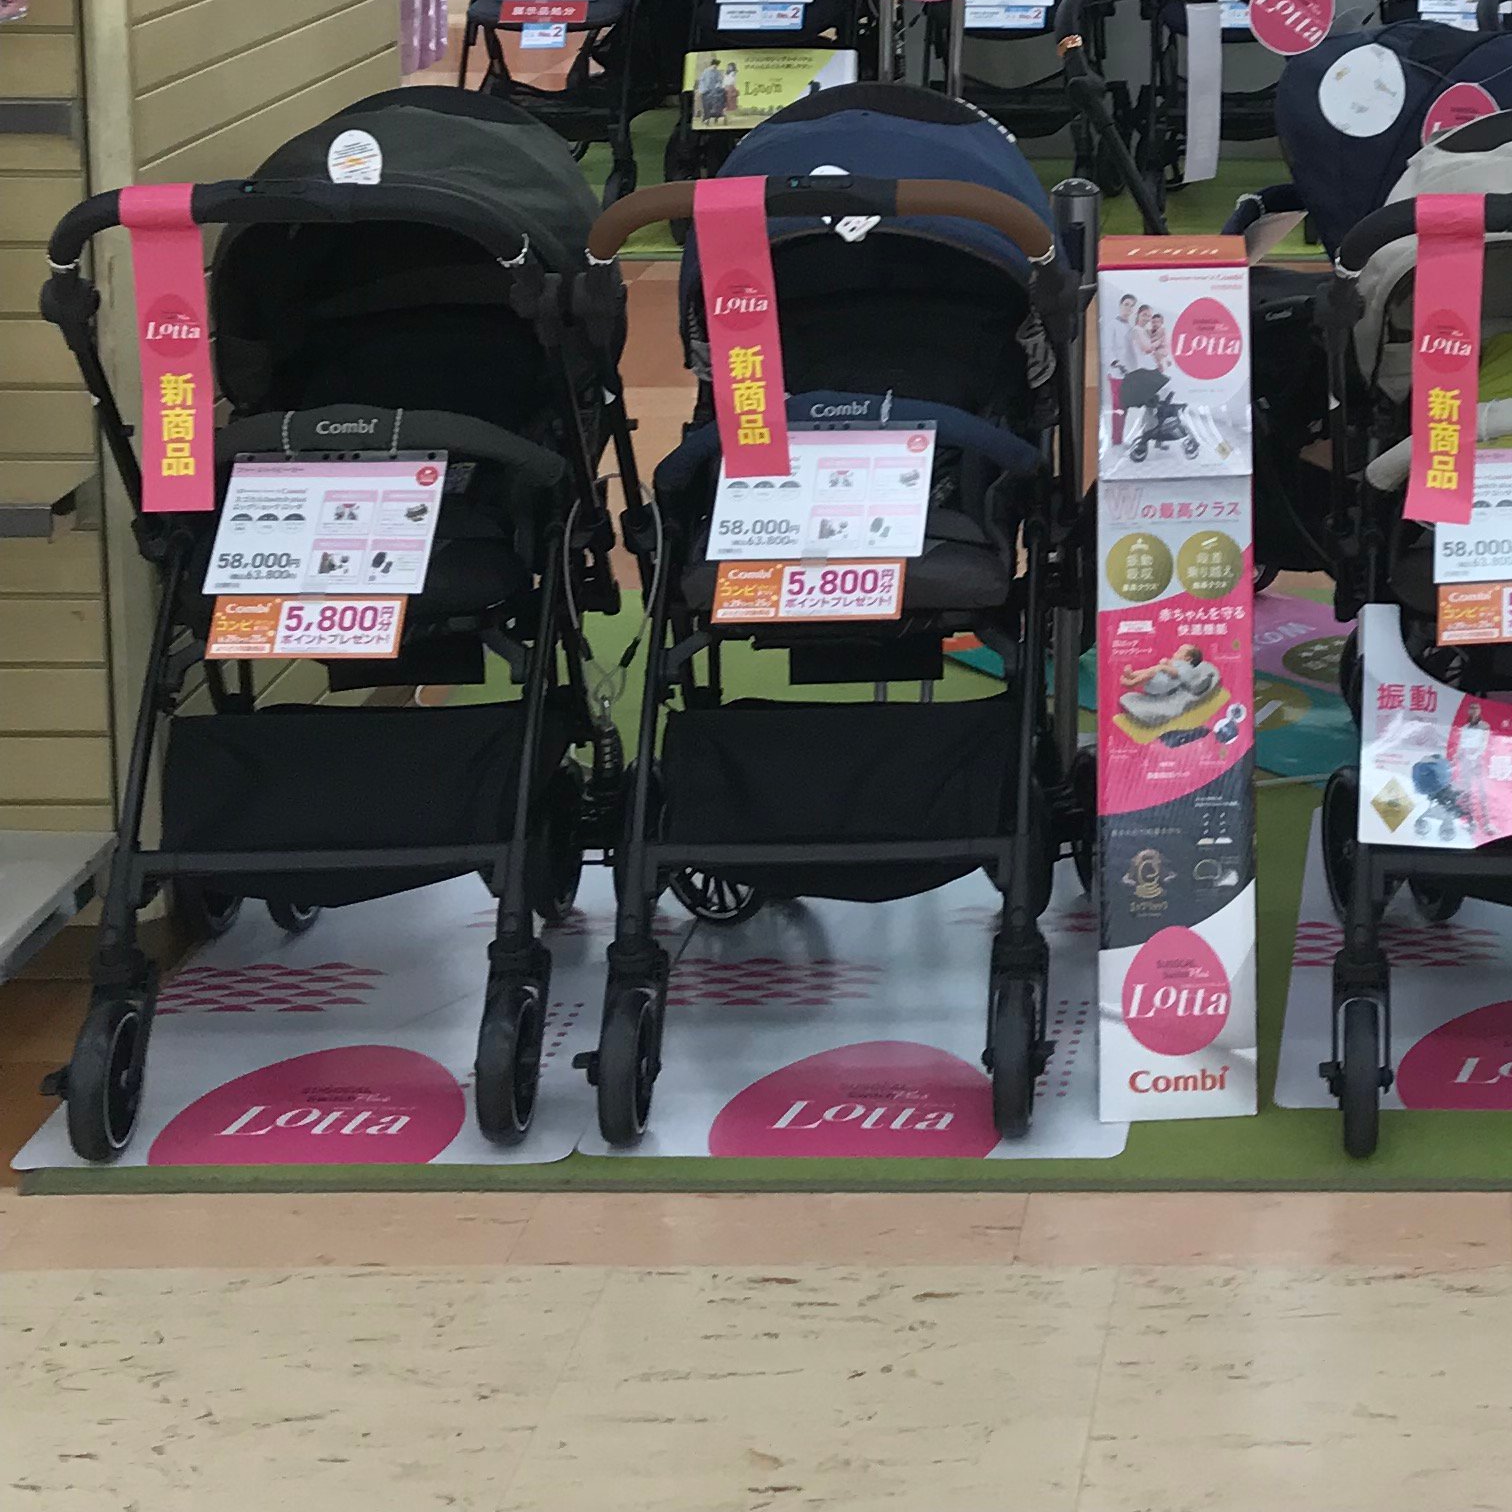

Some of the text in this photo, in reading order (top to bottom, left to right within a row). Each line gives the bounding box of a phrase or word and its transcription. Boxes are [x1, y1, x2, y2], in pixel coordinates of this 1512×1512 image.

[713, 295, 769, 317] Lotta
[145, 318, 201, 341] Lotta
[1174, 332, 1242, 356] Lotta
[1418, 334, 1473, 358] Lotta
[728, 344, 771, 447] 新商品
[810, 399, 872, 420] Combi
[159, 373, 197, 477] 新商品
[315, 417, 379, 437] Combi
[1426, 386, 1463, 491] 新商品
[719, 519, 800, 535] 58,000円
[217, 552, 301, 570] 58,000円
[728, 569, 773, 580] Combi
[787, 569, 879, 596] 5,800
[225, 603, 272, 614] Combi
[285, 605, 378, 631] 5,800
[1376, 682, 1438, 714] 振動
[1126, 982, 1229, 1019] Lotta
[1128, 1065, 1231, 1094] Combi
[215, 1104, 411, 1136] Lotta
[766, 1100, 955, 1130] Lotta
